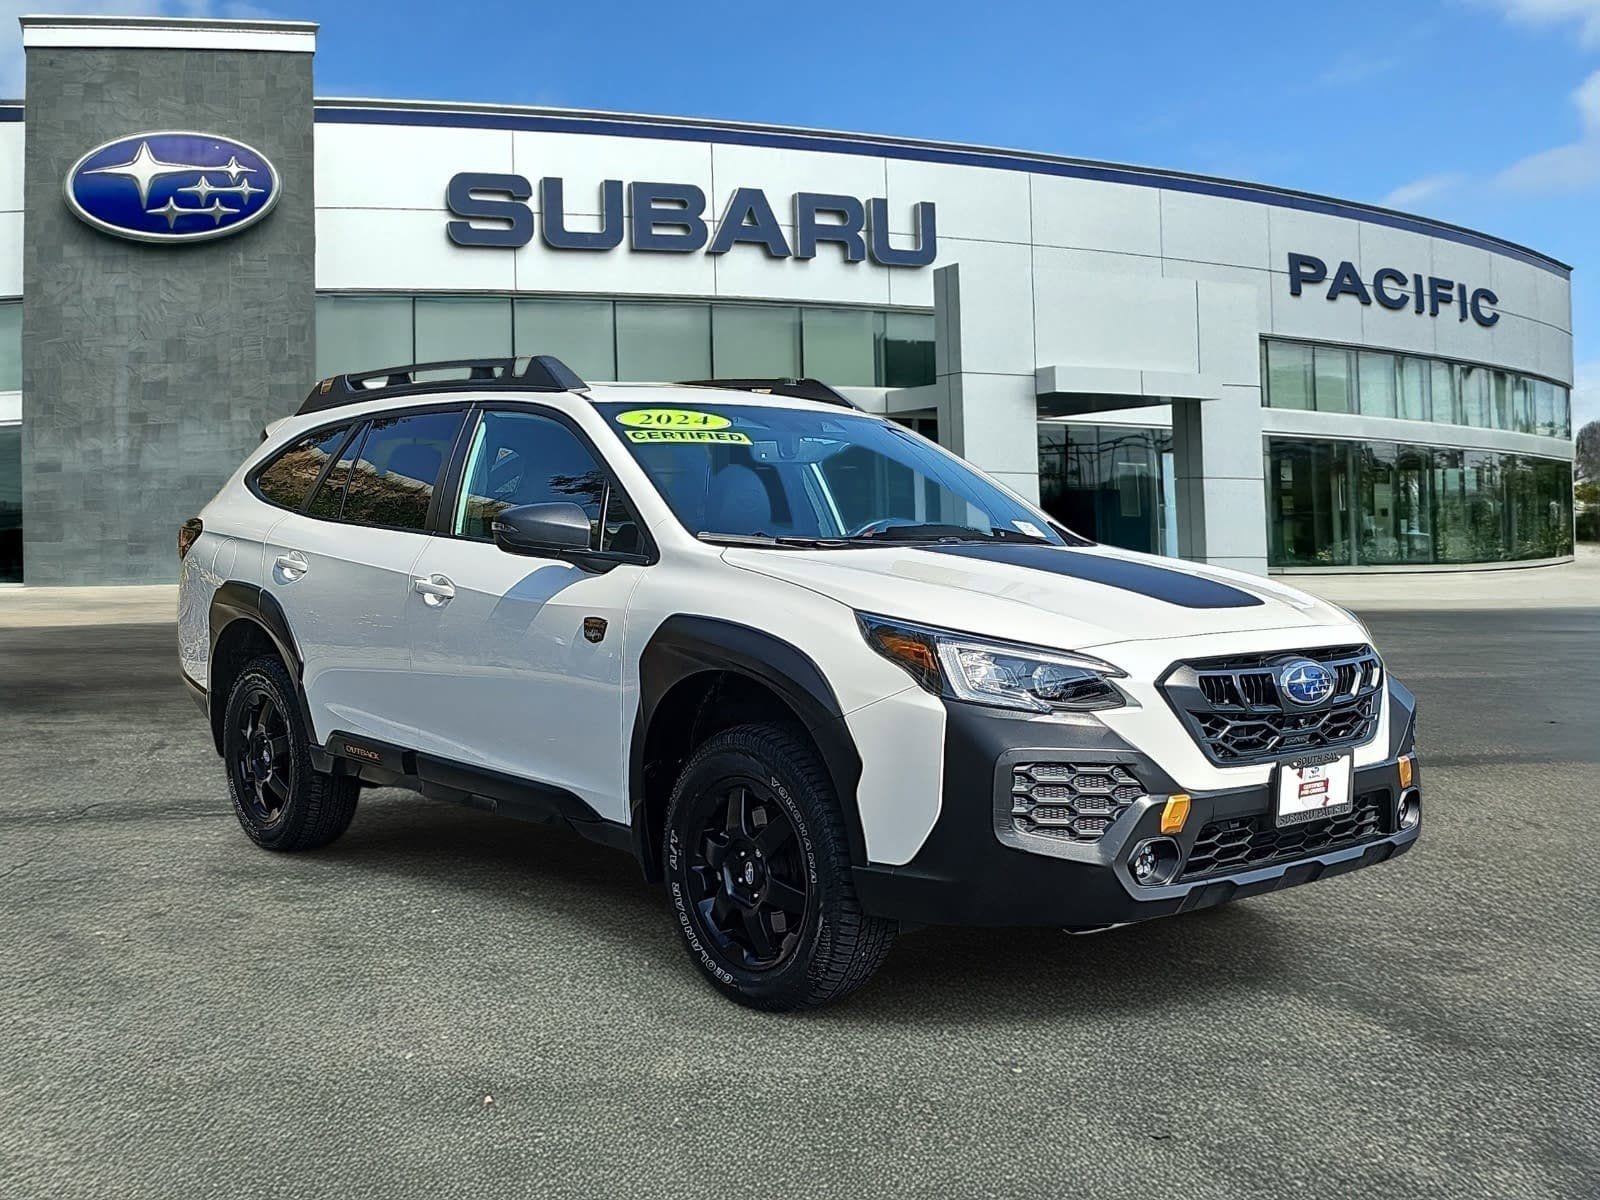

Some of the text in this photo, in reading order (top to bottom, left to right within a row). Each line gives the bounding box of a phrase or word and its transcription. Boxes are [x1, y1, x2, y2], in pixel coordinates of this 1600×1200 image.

[447, 172, 937, 268] SUBARU
[1287, 252, 1500, 327] PACIFIC
[631, 431, 743, 442] CERTIFIED
[639, 413, 710, 425] 2024
[345, 744, 381, 761] OUTBACK
[1297, 754, 1322, 767] SOUTH
[770, 776, 817, 884] YOKOHAMA
[669, 829, 734, 985] GEOLANDAR A/T
